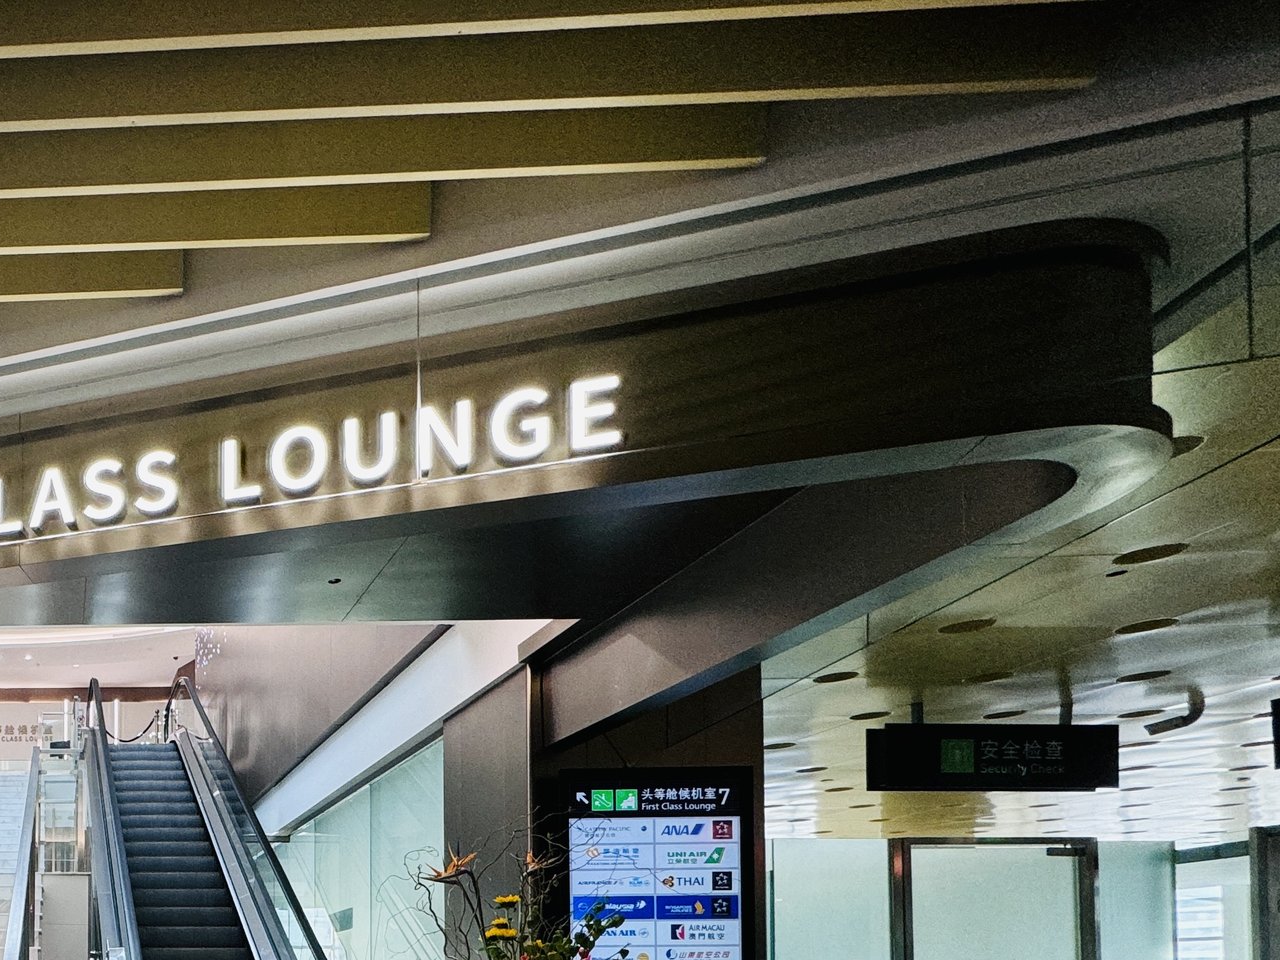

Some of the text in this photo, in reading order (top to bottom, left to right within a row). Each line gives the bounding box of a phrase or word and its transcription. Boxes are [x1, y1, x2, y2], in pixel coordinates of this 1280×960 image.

[220, 374, 623, 502] LOUNGE
[981, 740, 1064, 760] 安全检查
[640, 788, 731, 806] 头等舱候机室 7
[641, 802, 717, 812] First Class Lounge
[661, 825, 690, 836] ANA
[676, 877, 705, 886] THAI
[619, 929, 637, 937] AIR
